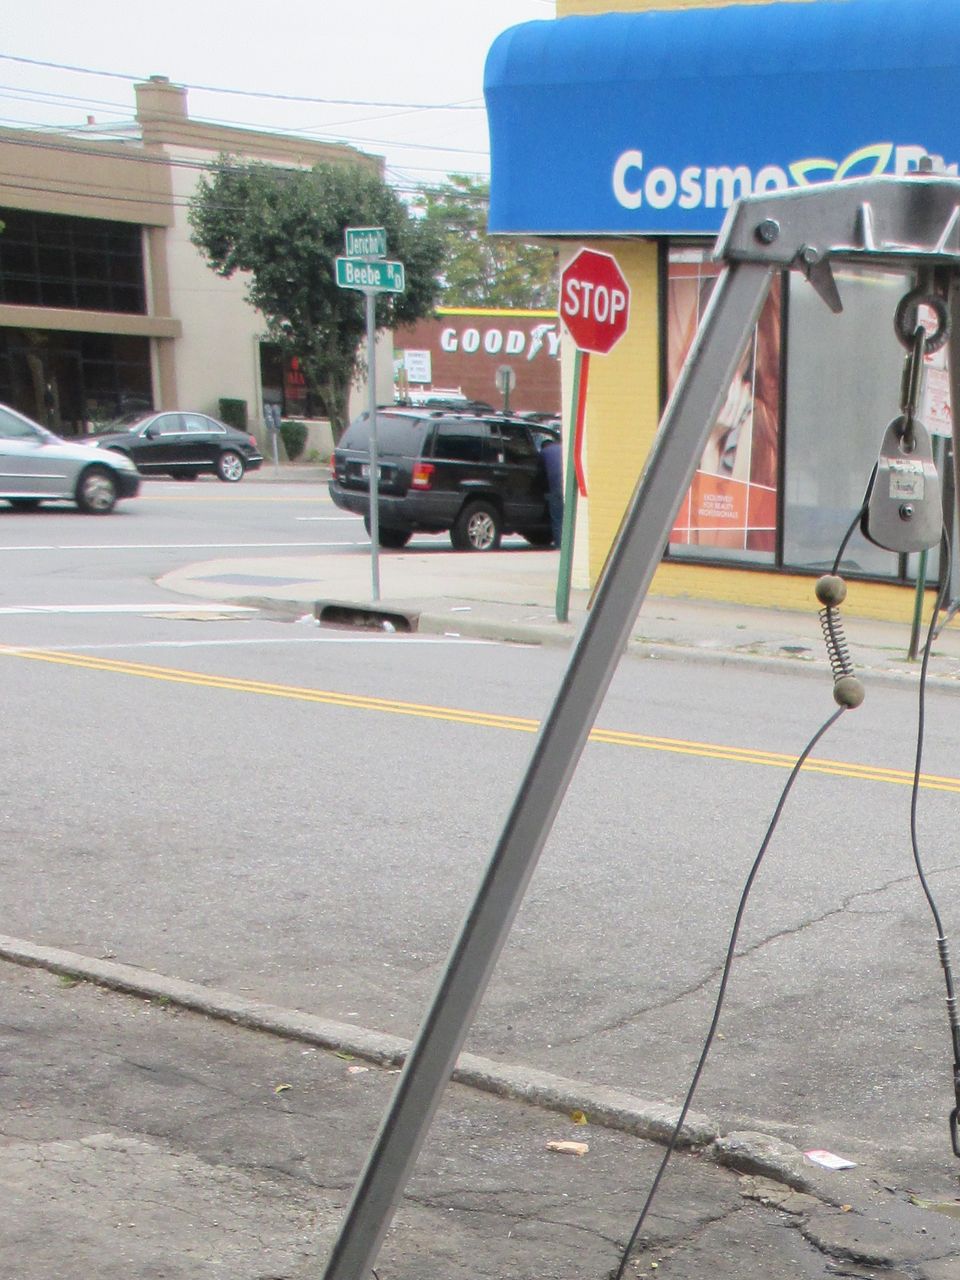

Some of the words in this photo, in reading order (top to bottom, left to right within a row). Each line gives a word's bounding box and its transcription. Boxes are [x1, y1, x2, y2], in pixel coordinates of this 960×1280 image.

[613, 150, 788, 209] Cosmo
[346, 262, 381, 285] Beebe
[565, 279, 625, 325] STOP
